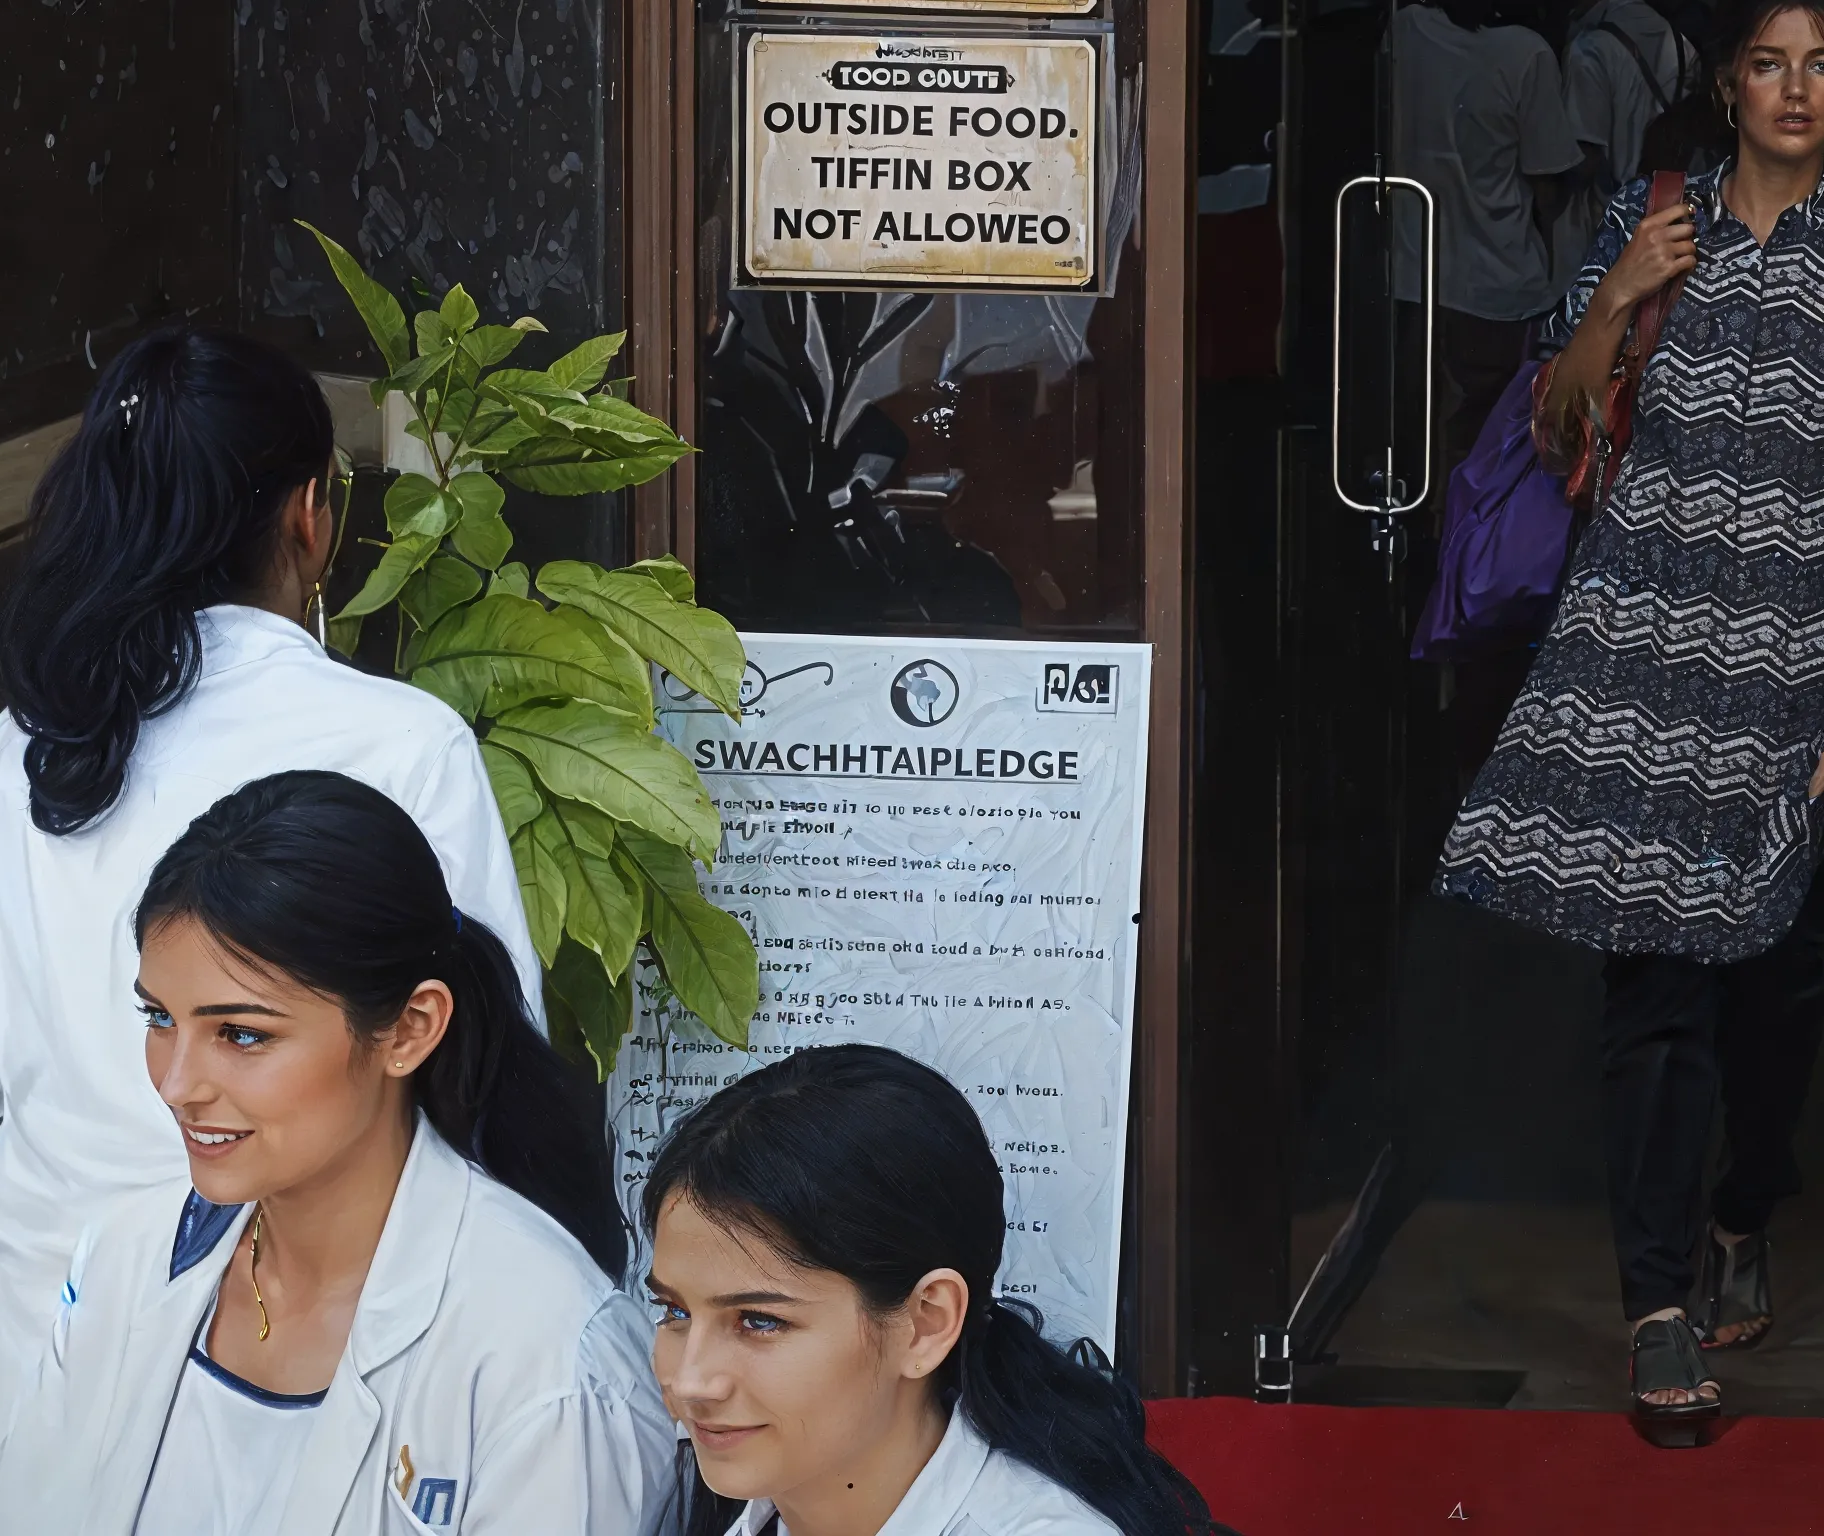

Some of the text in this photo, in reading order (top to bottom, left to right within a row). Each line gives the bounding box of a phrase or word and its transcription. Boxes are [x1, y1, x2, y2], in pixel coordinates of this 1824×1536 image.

[763, 101, 1080, 140] OUTSIDE FOOD.
[810, 156, 1033, 192] TIFFIN BOX
[773, 207, 862, 241] NOT
